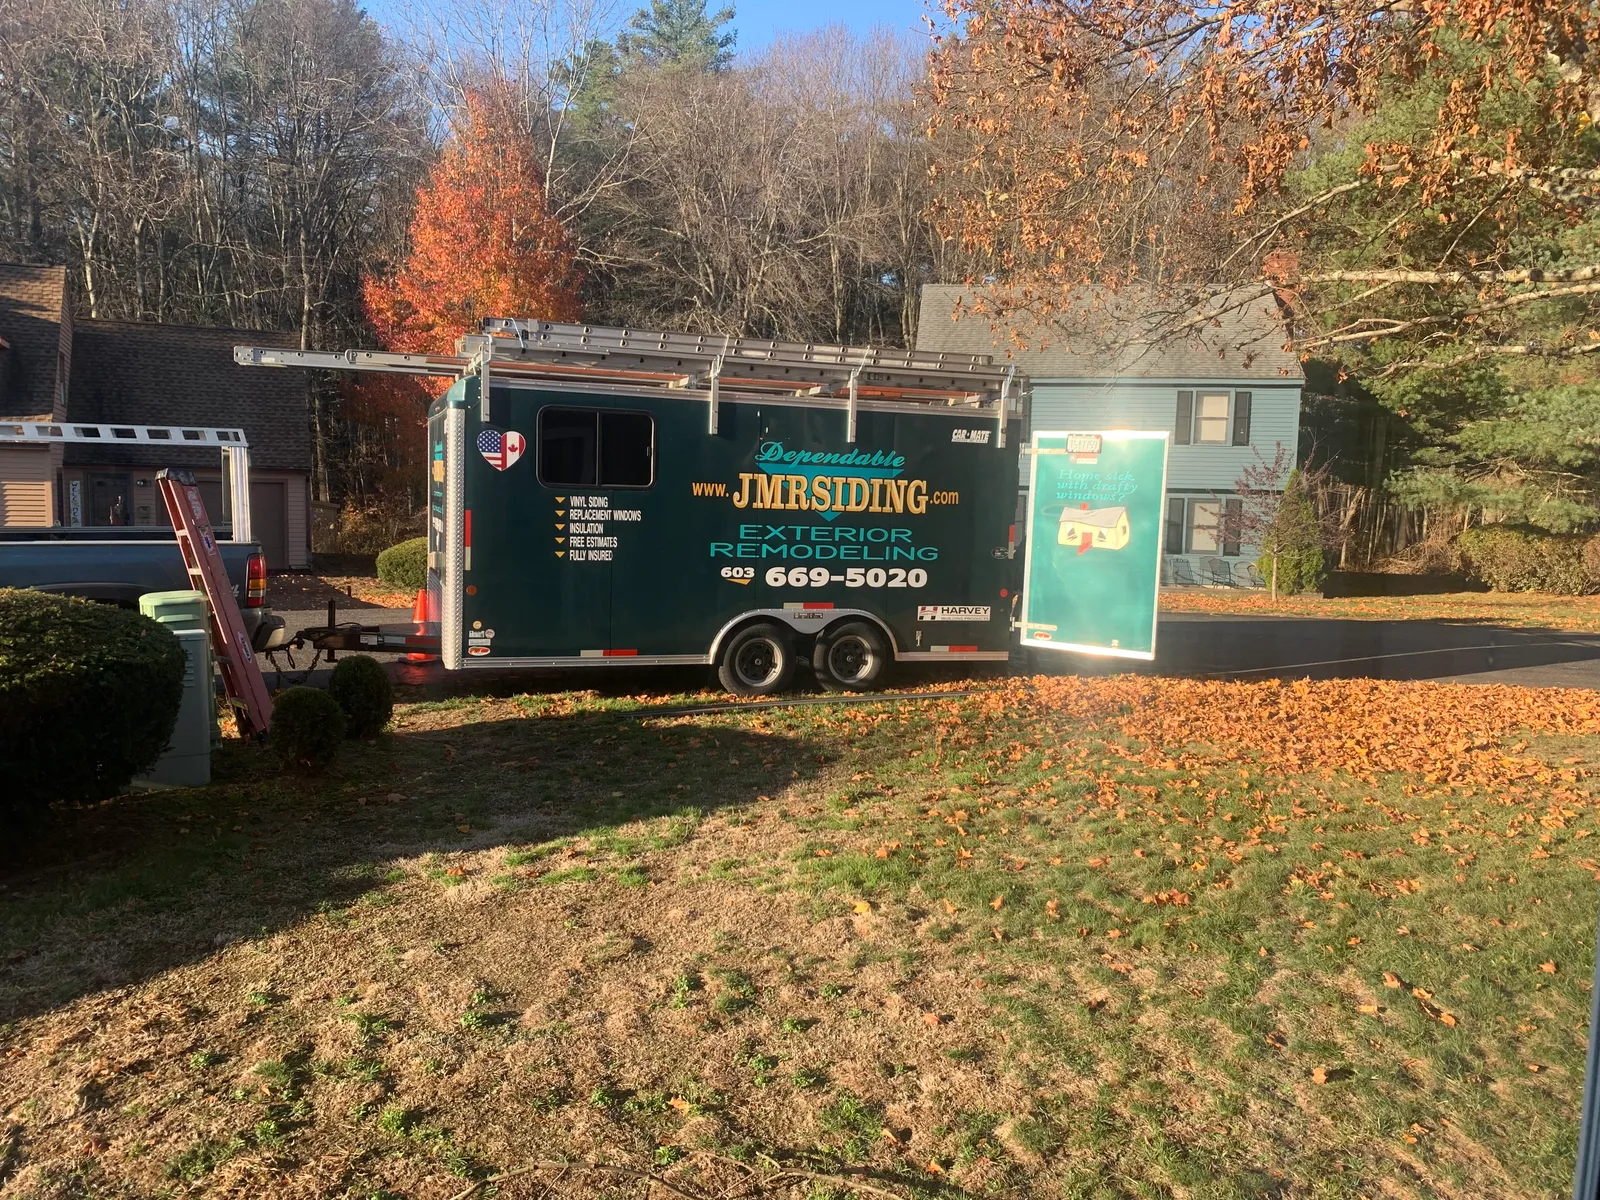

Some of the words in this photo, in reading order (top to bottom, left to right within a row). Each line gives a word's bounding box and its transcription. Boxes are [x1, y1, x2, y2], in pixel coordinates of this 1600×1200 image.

[754, 441, 906, 466] Dependable
[1058, 469, 1101, 480] Home
[1105, 470, 1136, 481] sick
[1056, 479, 1088, 490] with
[1092, 480, 1138, 495] drafty
[569, 495, 587, 507] VINYL
[588, 496, 609, 508] SIDING
[1055, 490, 1127, 502] windows?
[569, 509, 612, 521] REPLACEMENT
[613, 509, 642, 522] WINDOWS
[569, 523, 604, 535] INSULATION
[739, 524, 912, 543] EXTERIOR
[569, 536, 585, 548] FREE
[586, 536, 618, 548] ESTIMATES
[569, 550, 587, 561] FULLY
[587, 550, 613, 561] INSURED
[710, 543, 939, 561] REMODELING
[720, 566, 755, 579] 603
[765, 567, 928, 588] 669-5020
[941, 606, 990, 615] HARVEY
